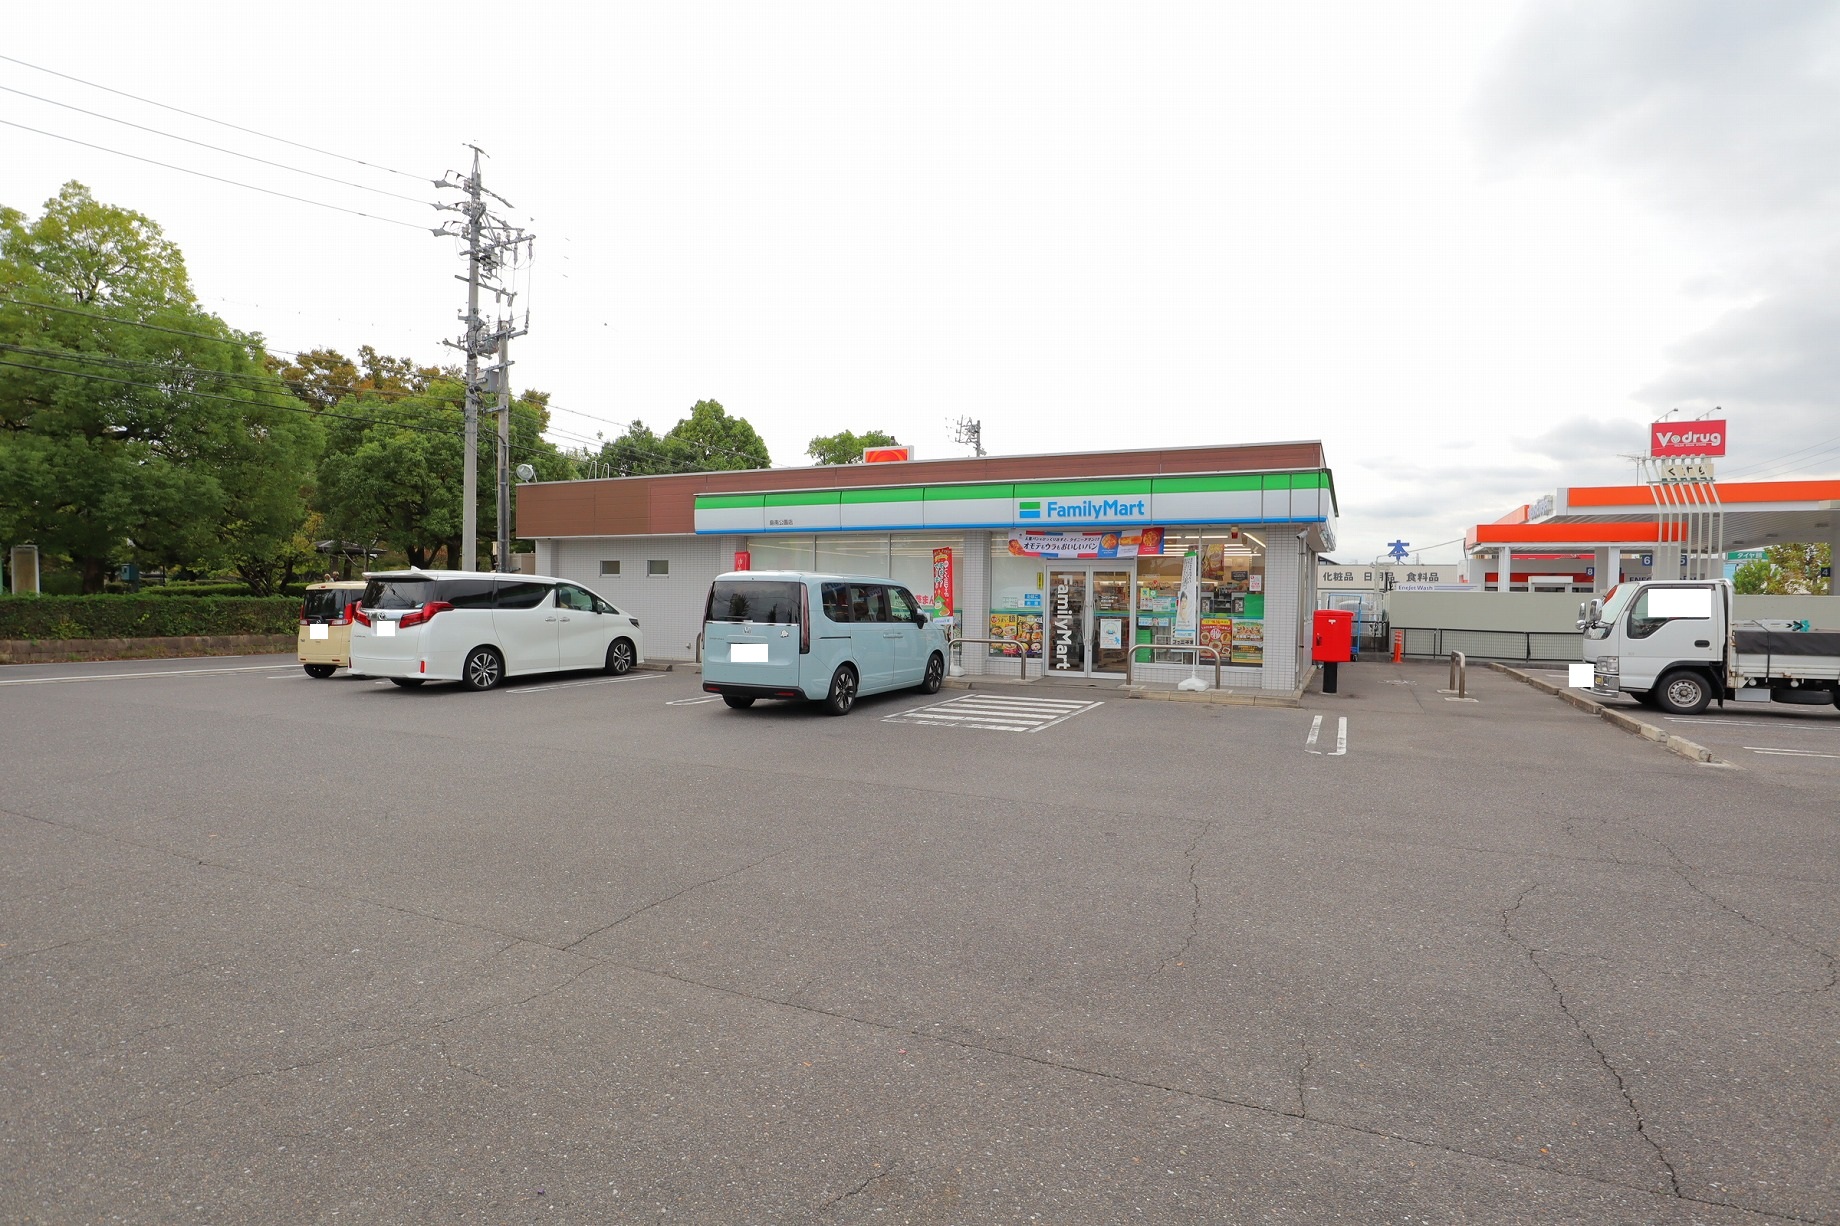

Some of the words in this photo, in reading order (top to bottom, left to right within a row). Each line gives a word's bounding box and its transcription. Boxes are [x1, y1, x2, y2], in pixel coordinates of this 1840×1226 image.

[1047, 500, 1145, 519] FamilyMart
[1643, 556, 1651, 565] 6
[1323, 571, 1354, 582] 化粧品
[1406, 571, 1439, 582] 食料品
[1821, 568, 1829, 576] 4
[1056, 574, 1073, 670] FamilyMart
